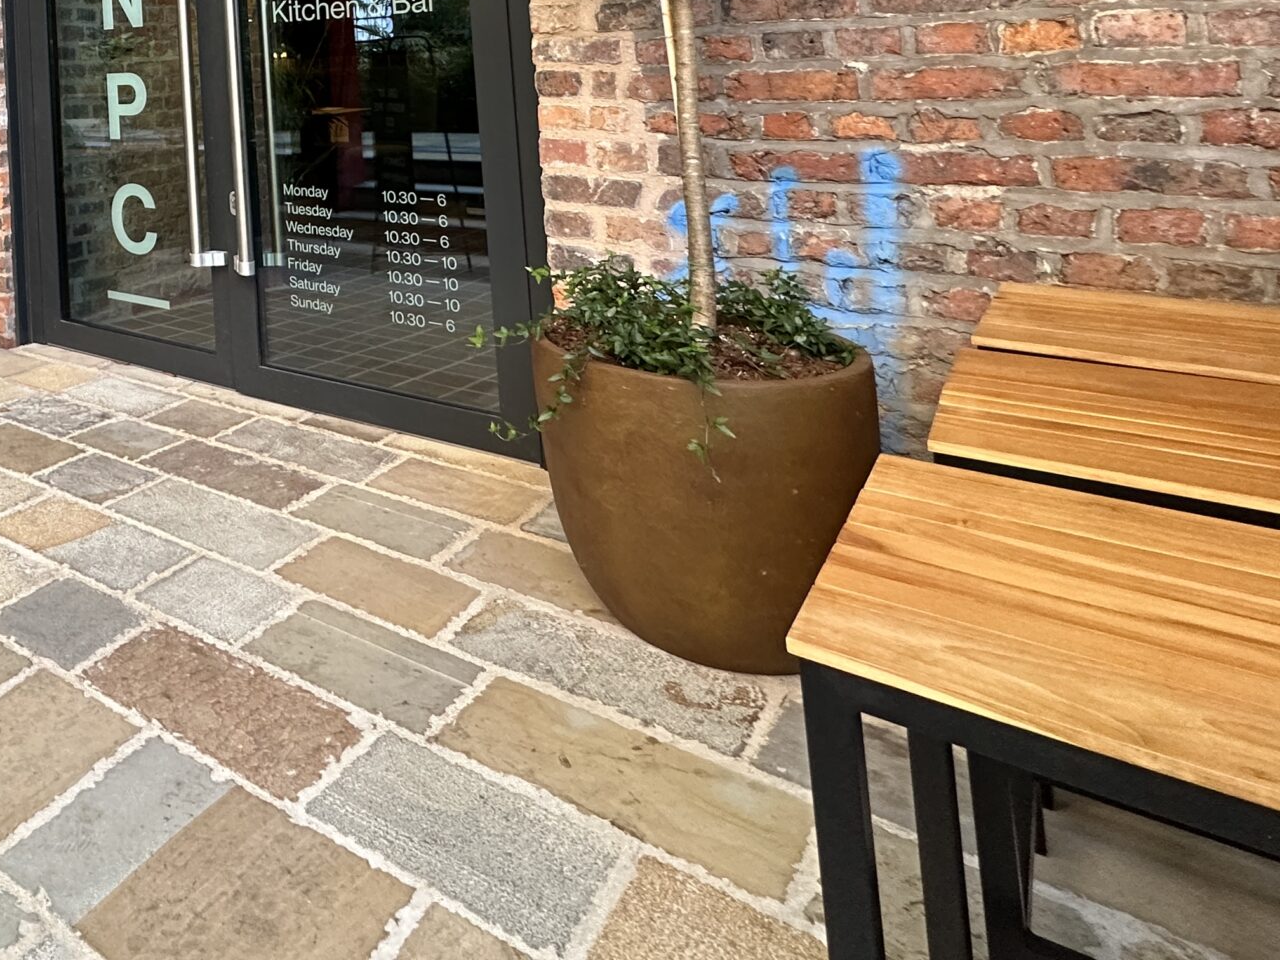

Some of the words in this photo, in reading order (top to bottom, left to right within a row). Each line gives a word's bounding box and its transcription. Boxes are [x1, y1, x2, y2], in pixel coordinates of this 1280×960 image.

[282, 183, 329, 201] Monday
[284, 201, 333, 220] Tuesday
[285, 220, 354, 241] Wednesday
[287, 239, 341, 258] Thursday
[287, 257, 322, 276] Friday
[289, 276, 341, 297] Saturday
[290, 294, 334, 315] Sunday
